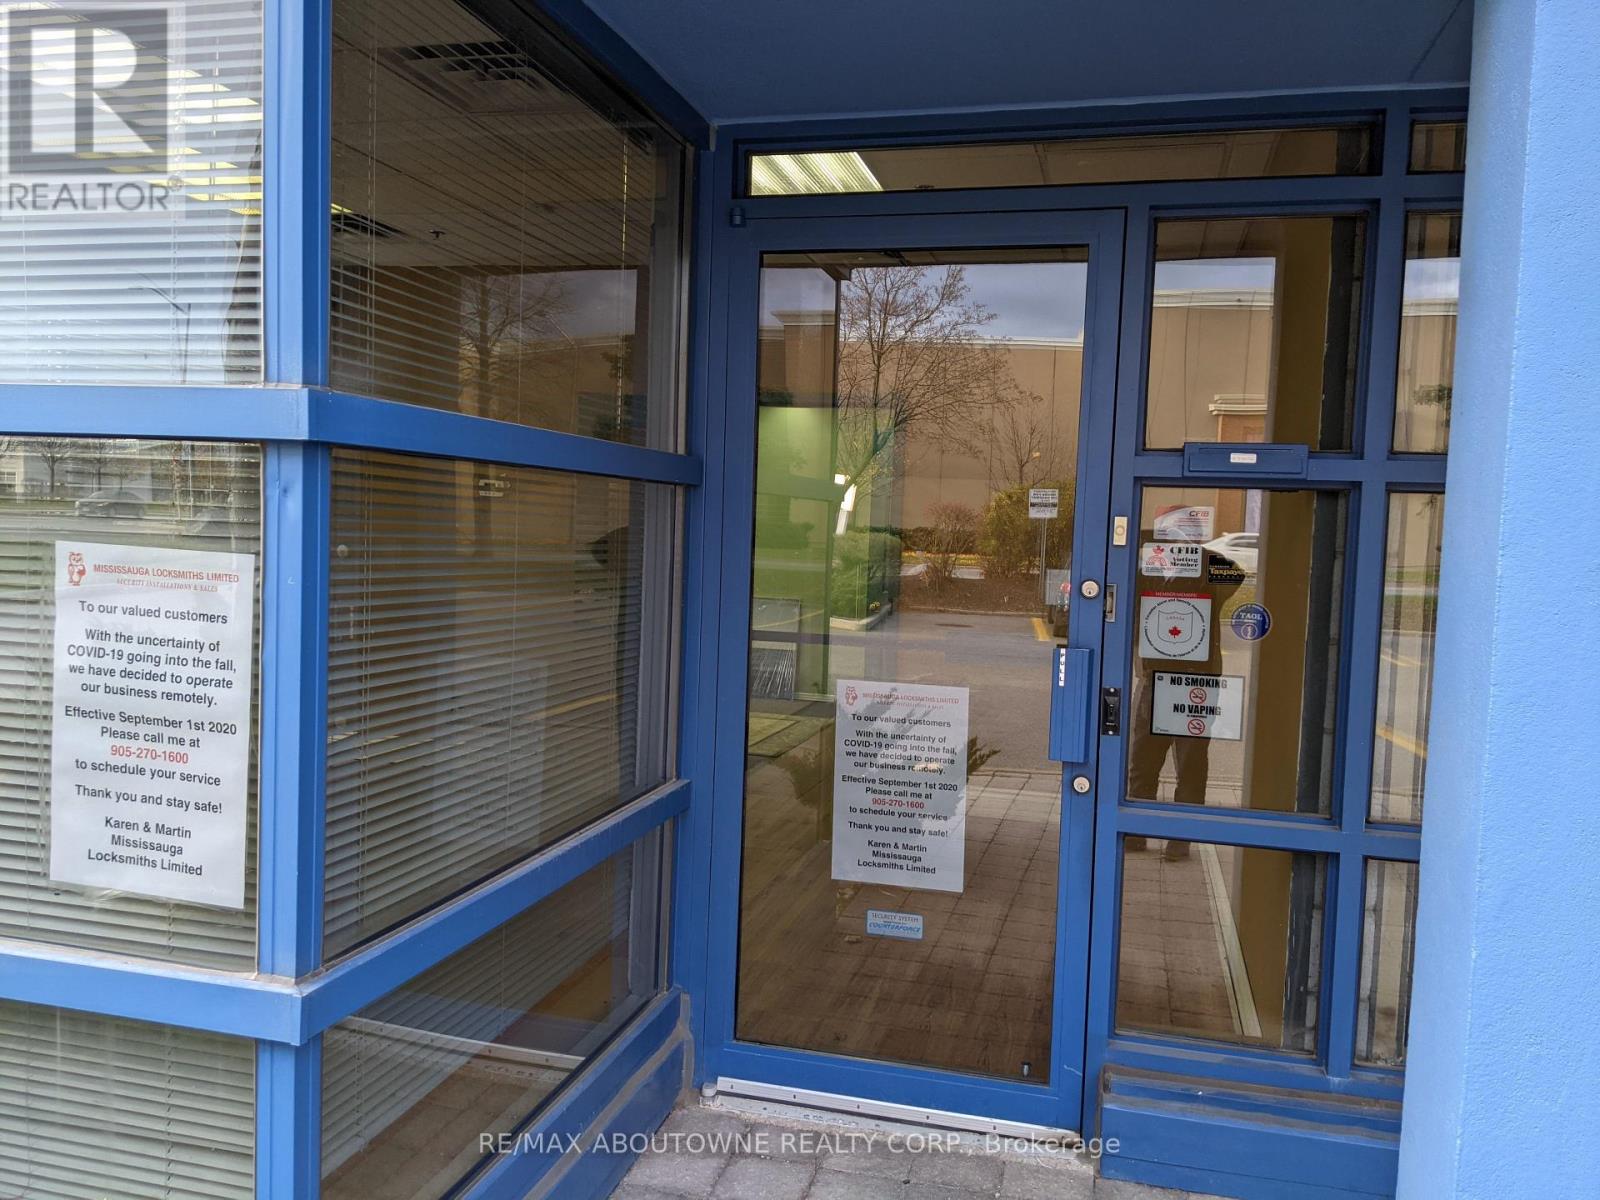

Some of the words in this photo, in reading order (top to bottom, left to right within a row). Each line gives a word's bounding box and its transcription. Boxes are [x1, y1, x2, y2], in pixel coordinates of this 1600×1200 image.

[93, 564, 150, 576] MISSISSAUGA
[152, 568, 204, 580] LOCKSMITHS
[206, 572, 239, 583] LIMITED
[79, 600, 94, 612] To
[98, 604, 118, 614] our
[122, 604, 160, 618] valued
[164, 609, 228, 624] customers
[85, 628, 111, 642] With
[115, 631, 134, 644] the
[137, 634, 205, 653] uncertainty
[208, 640, 220, 652] of
[68, 644, 124, 660] COVID-19
[128, 651, 161, 666] going
[165, 654, 188, 666] into
[192, 657, 212, 669] the
[215, 658, 236, 672] fall,
[69, 664, 84, 674] we
[88, 664, 116, 677] have
[120, 667, 166, 682] decided
[170, 672, 182, 684] to
[186, 675, 233, 688] operate
[1170, 676, 1182, 686] NO
[1185, 677, 1228, 688] SMOKING
[81, 682, 101, 692] our
[104, 682, 158, 699] business
[161, 688, 218, 708] remotely.
[1173, 704, 1186, 712] NO
[1188, 705, 1221, 716] VAPING
[65, 706, 116, 721] Effective
[119, 712, 182, 730] September
[188, 720, 205, 732] 1st
[208, 722, 237, 735] 2020
[880, 716, 906, 724] valued
[908, 718, 952, 728] customers
[101, 726, 140, 740] Please
[144, 732, 164, 744] call
[168, 736, 186, 746] me
[189, 737, 200, 748] at
[876, 731, 888, 739] the
[890, 733, 936, 744] uncertainty
[110, 745, 189, 764] 905-270-1600
[844, 739, 882, 748] COVID-19
[884, 742, 908, 752] going
[910, 743, 926, 752] into
[928, 745, 940, 753] the
[942, 746, 957, 756] fall,
[858, 750, 878, 758] have
[880, 752, 912, 761] decided
[924, 756, 955, 765] operate
[870, 760, 906, 771] business
[76, 759, 87, 770] to
[92, 760, 146, 776] schedule
[150, 767, 176, 780] your
[180, 772, 221, 786] service
[842, 774, 876, 784] Effective
[878, 777, 921, 788] September
[924, 782, 936, 790] 1st
[938, 783, 958, 792] 2020
[75, 784, 112, 799] Thank
[116, 790, 137, 802] you
[140, 793, 162, 806] and
[166, 798, 190, 811] stay
[194, 799, 222, 814] safe!
[866, 787, 892, 796] Please
[894, 790, 908, 798] call
[872, 798, 924, 809] 905-270-1600
[860, 807, 896, 816] schedule
[918, 813, 948, 821] service
[105, 816, 139, 831] Karen
[144, 821, 152, 832] &
[156, 823, 192, 838] Martin
[848, 821, 872, 830] Thank
[908, 828, 926, 836] stay
[928, 829, 948, 837] safe!
[111, 834, 184, 856] Mississauga
[868, 840, 891, 848] Karen
[902, 843, 926, 852] Martin
[88, 848, 158, 868] Locksmiths
[160, 856, 202, 876] Limited
[872, 850, 922, 863] Mississauga
[858, 860, 904, 870] Locksmiths
[906, 864, 936, 874] Limited
